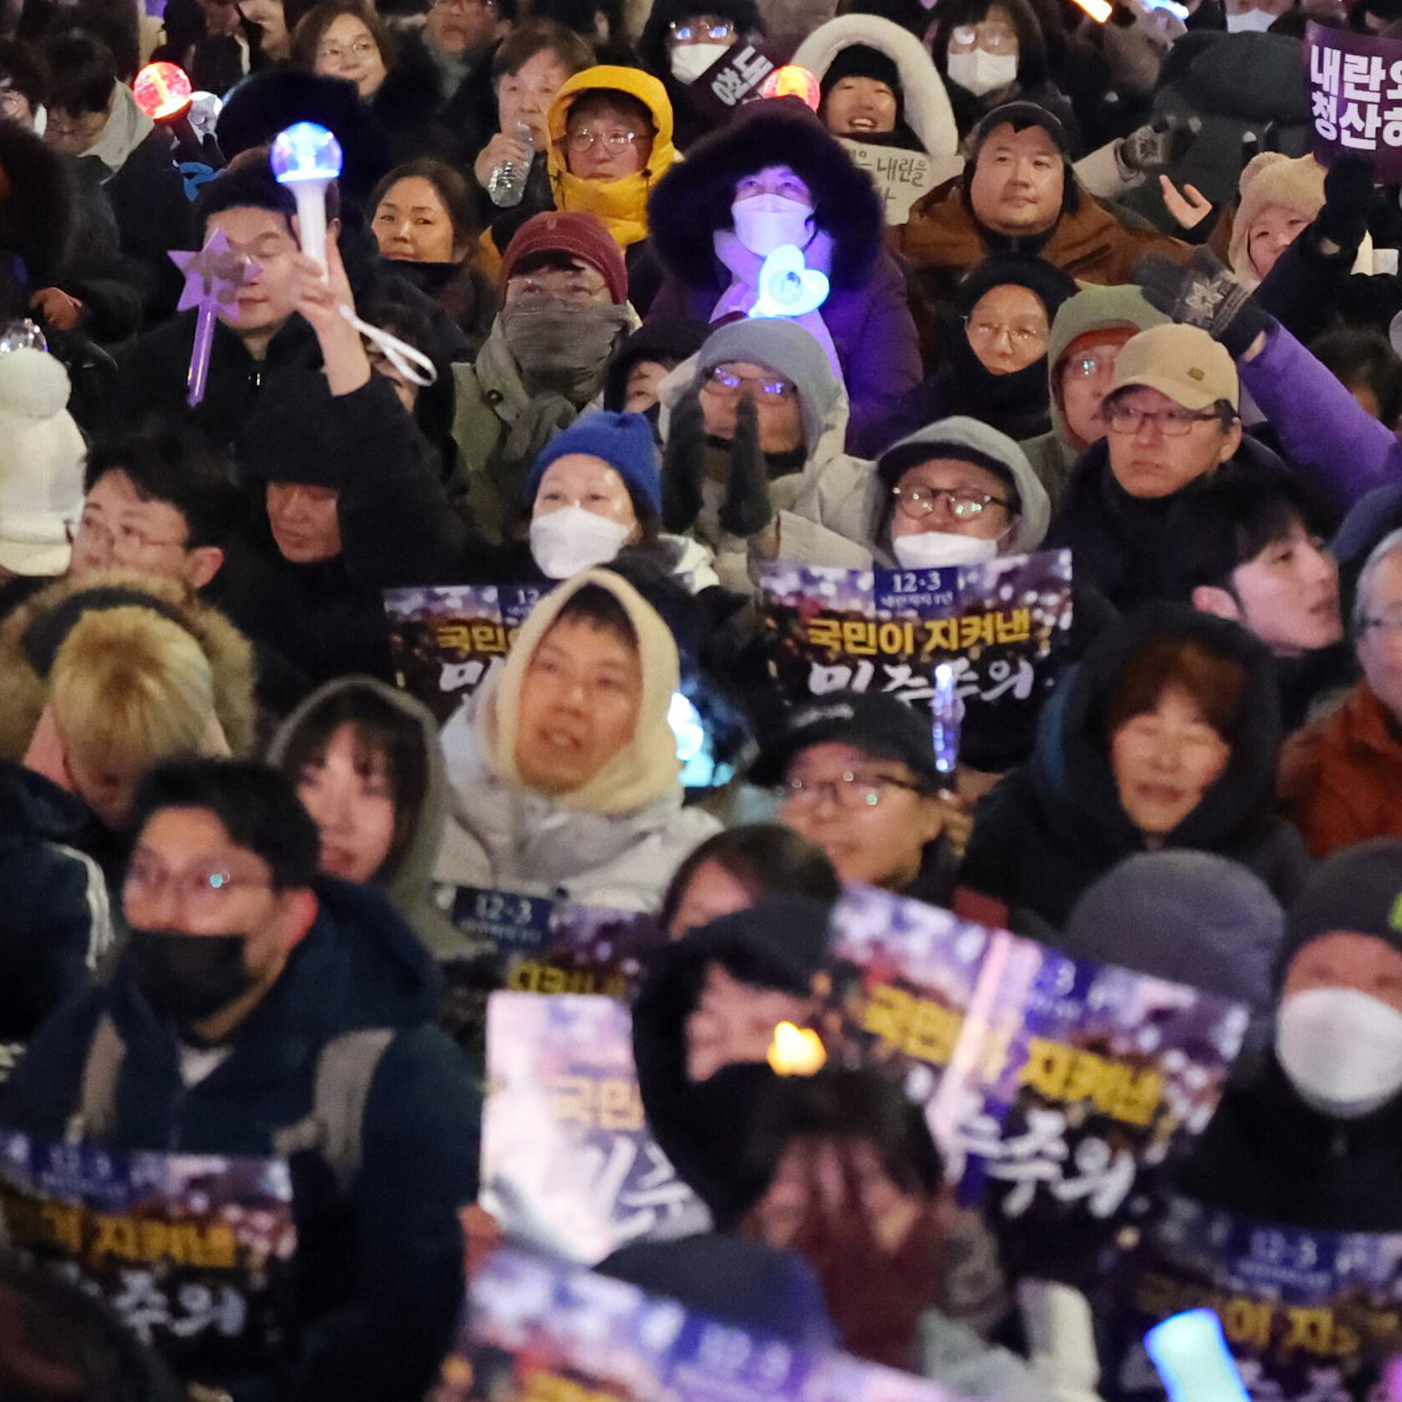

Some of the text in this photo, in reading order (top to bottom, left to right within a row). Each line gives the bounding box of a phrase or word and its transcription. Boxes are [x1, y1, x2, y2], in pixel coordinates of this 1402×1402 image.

[437, 625, 510, 655] 국민
[808, 608, 1031, 656] 국민이 지켜낸
